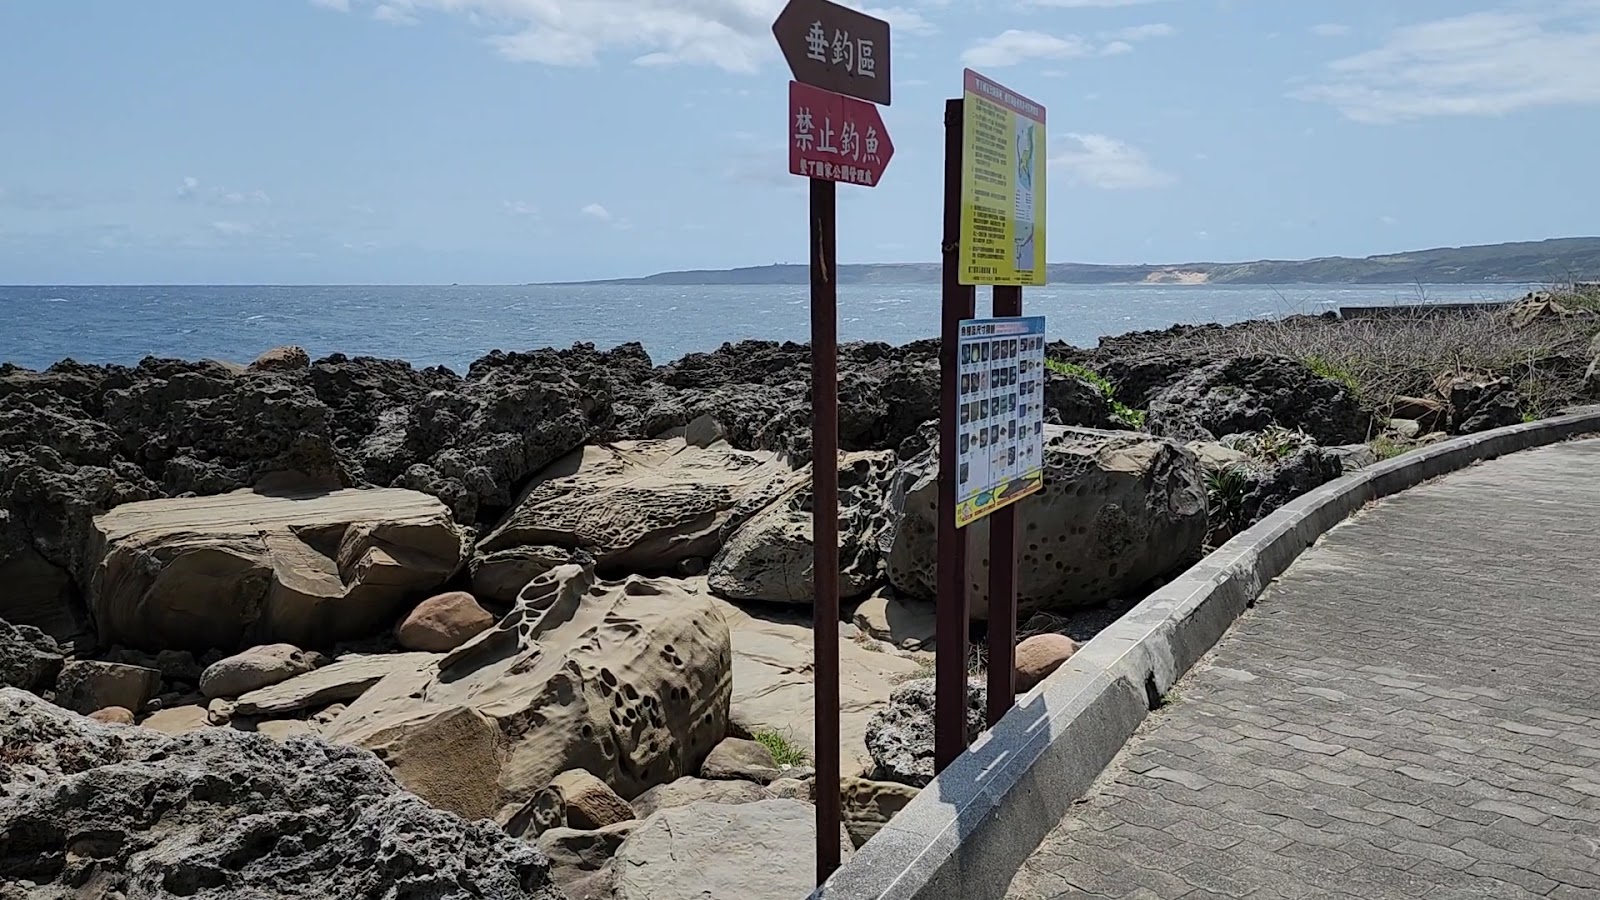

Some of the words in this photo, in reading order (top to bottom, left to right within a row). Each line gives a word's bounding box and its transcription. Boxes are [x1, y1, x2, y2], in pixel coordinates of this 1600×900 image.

[805, 20, 876, 78] 垂釣區
[795, 106, 881, 165] 禁止釣魚
[800, 157, 873, 185] 墾丁國家公園管理處
